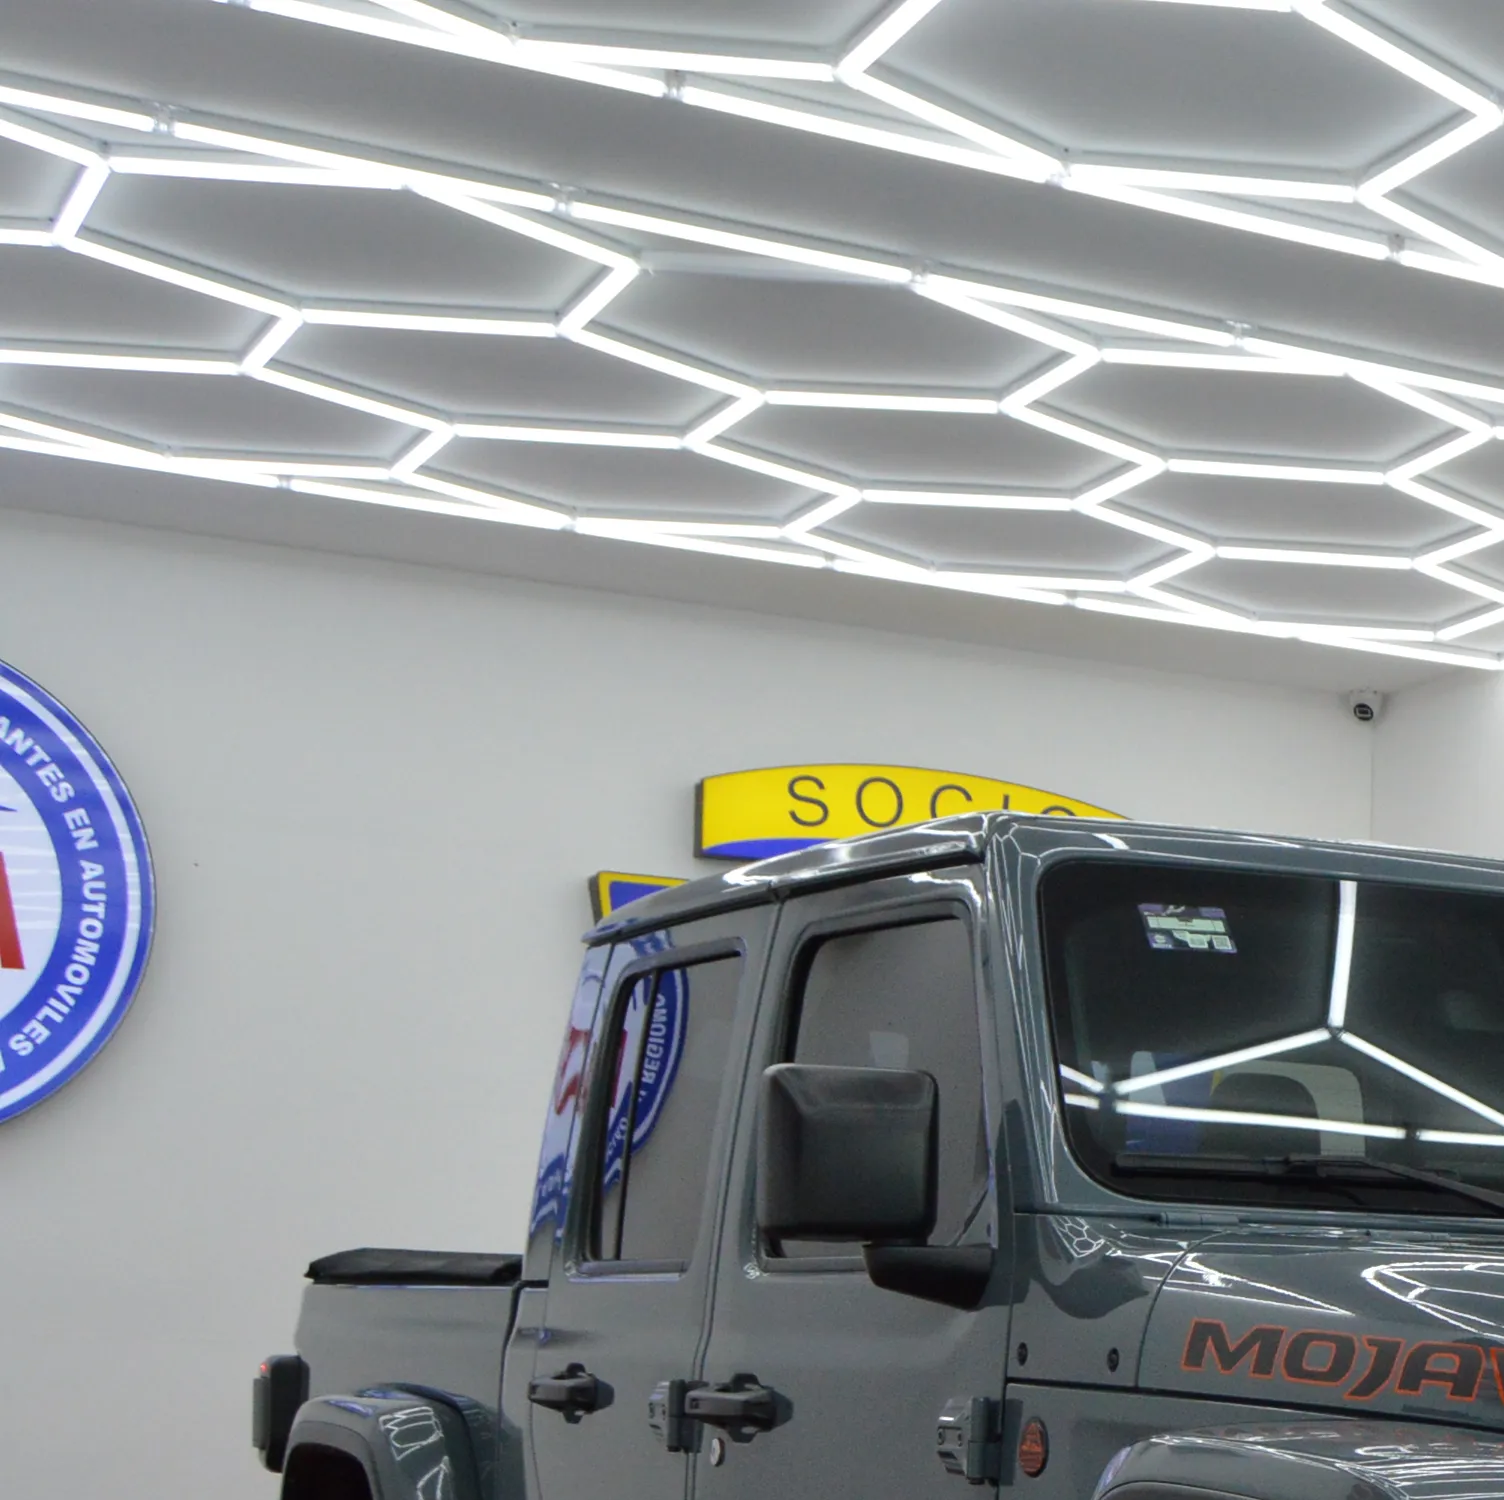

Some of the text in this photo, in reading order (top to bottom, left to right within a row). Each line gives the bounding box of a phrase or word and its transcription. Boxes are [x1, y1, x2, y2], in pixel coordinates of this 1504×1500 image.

[788, 774, 1077, 828] SOC
[63, 806, 99, 851] EN
[8, 858, 106, 1057] AUTOMOVILES
